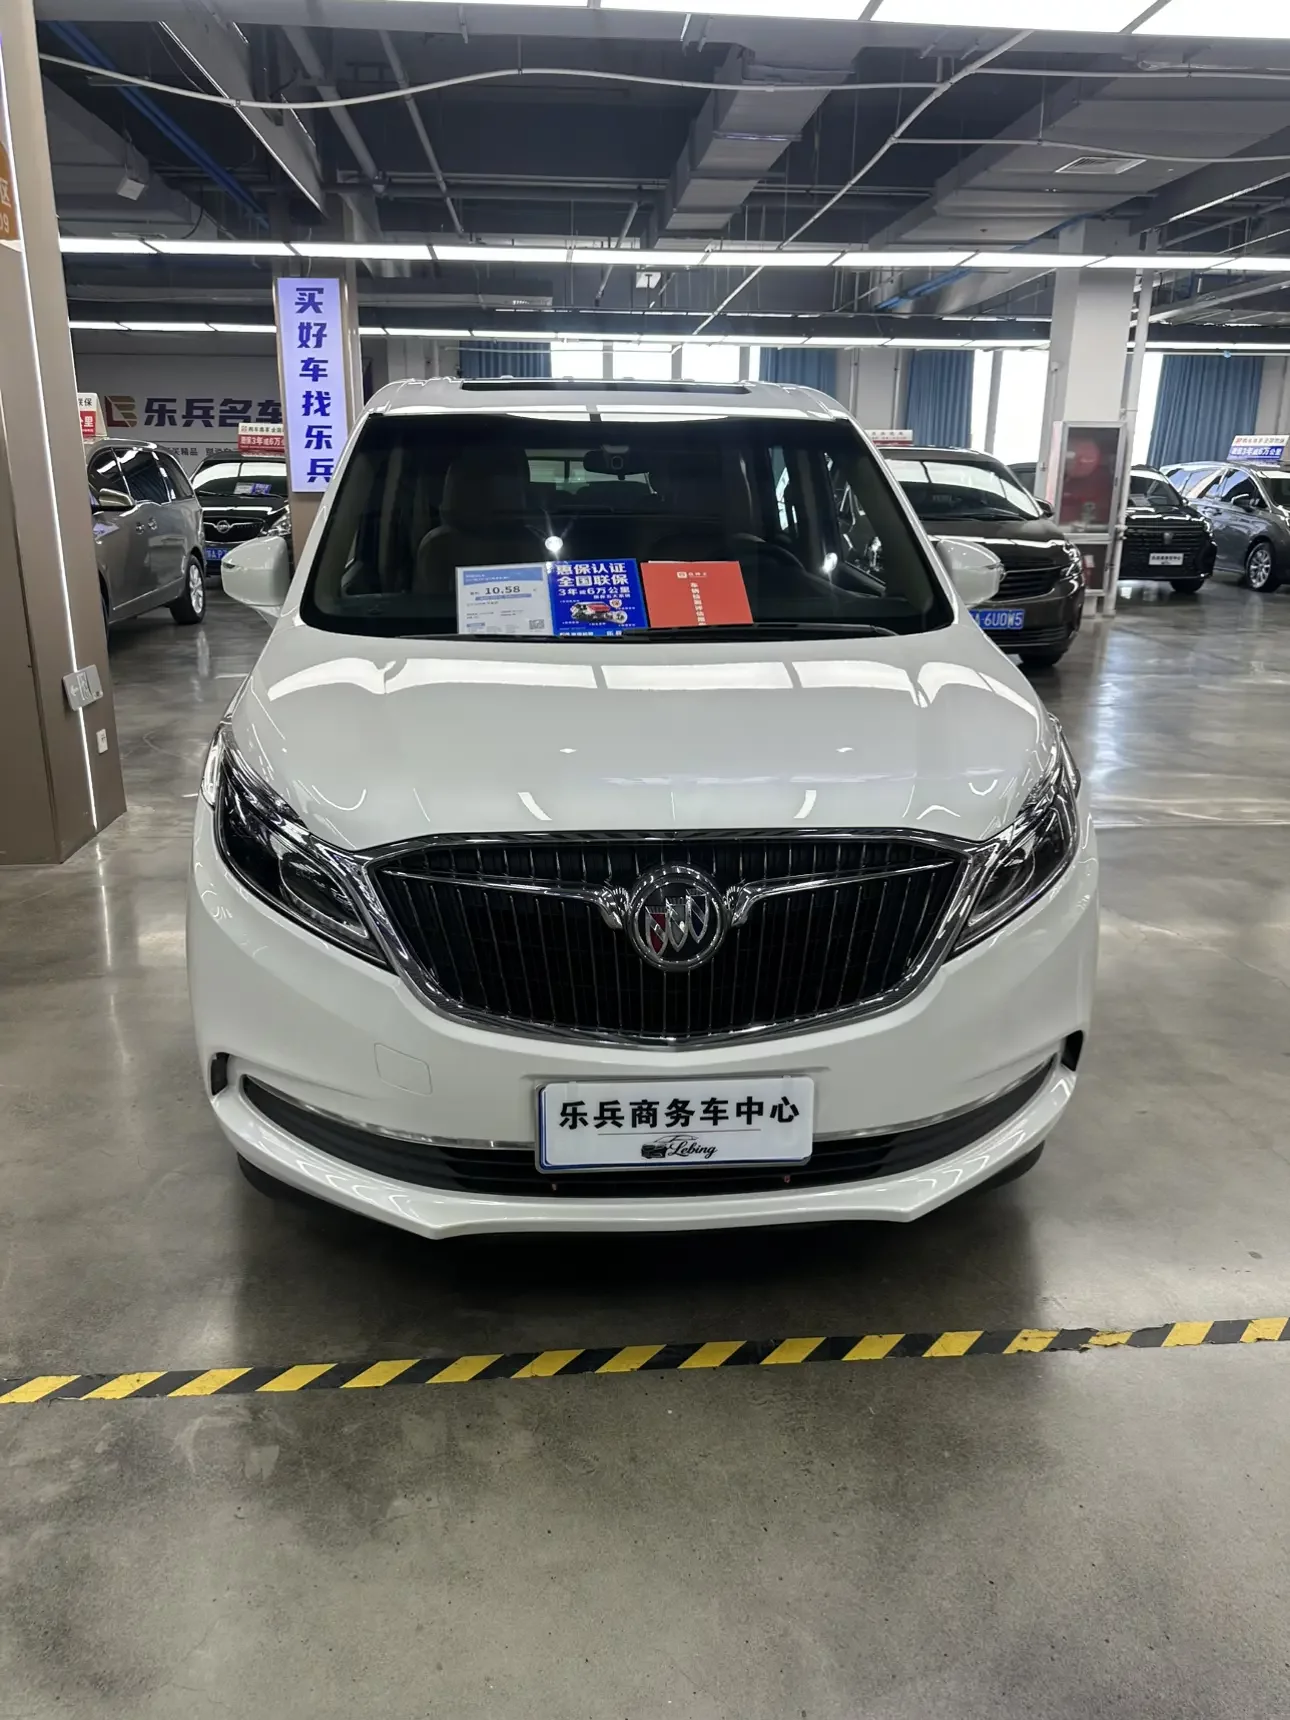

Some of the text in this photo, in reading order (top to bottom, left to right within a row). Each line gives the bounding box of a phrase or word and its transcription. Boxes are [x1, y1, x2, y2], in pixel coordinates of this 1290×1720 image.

[294, 287, 335, 483] 买好车找乐兵
[556, 562, 626, 575] 惠保认证
[557, 574, 629, 587] 全国联保
[485, 586, 521, 595] 10.58
[560, 1095, 800, 1130] 乐兵商务车中心
[667, 1139, 718, 1159] Lebing
